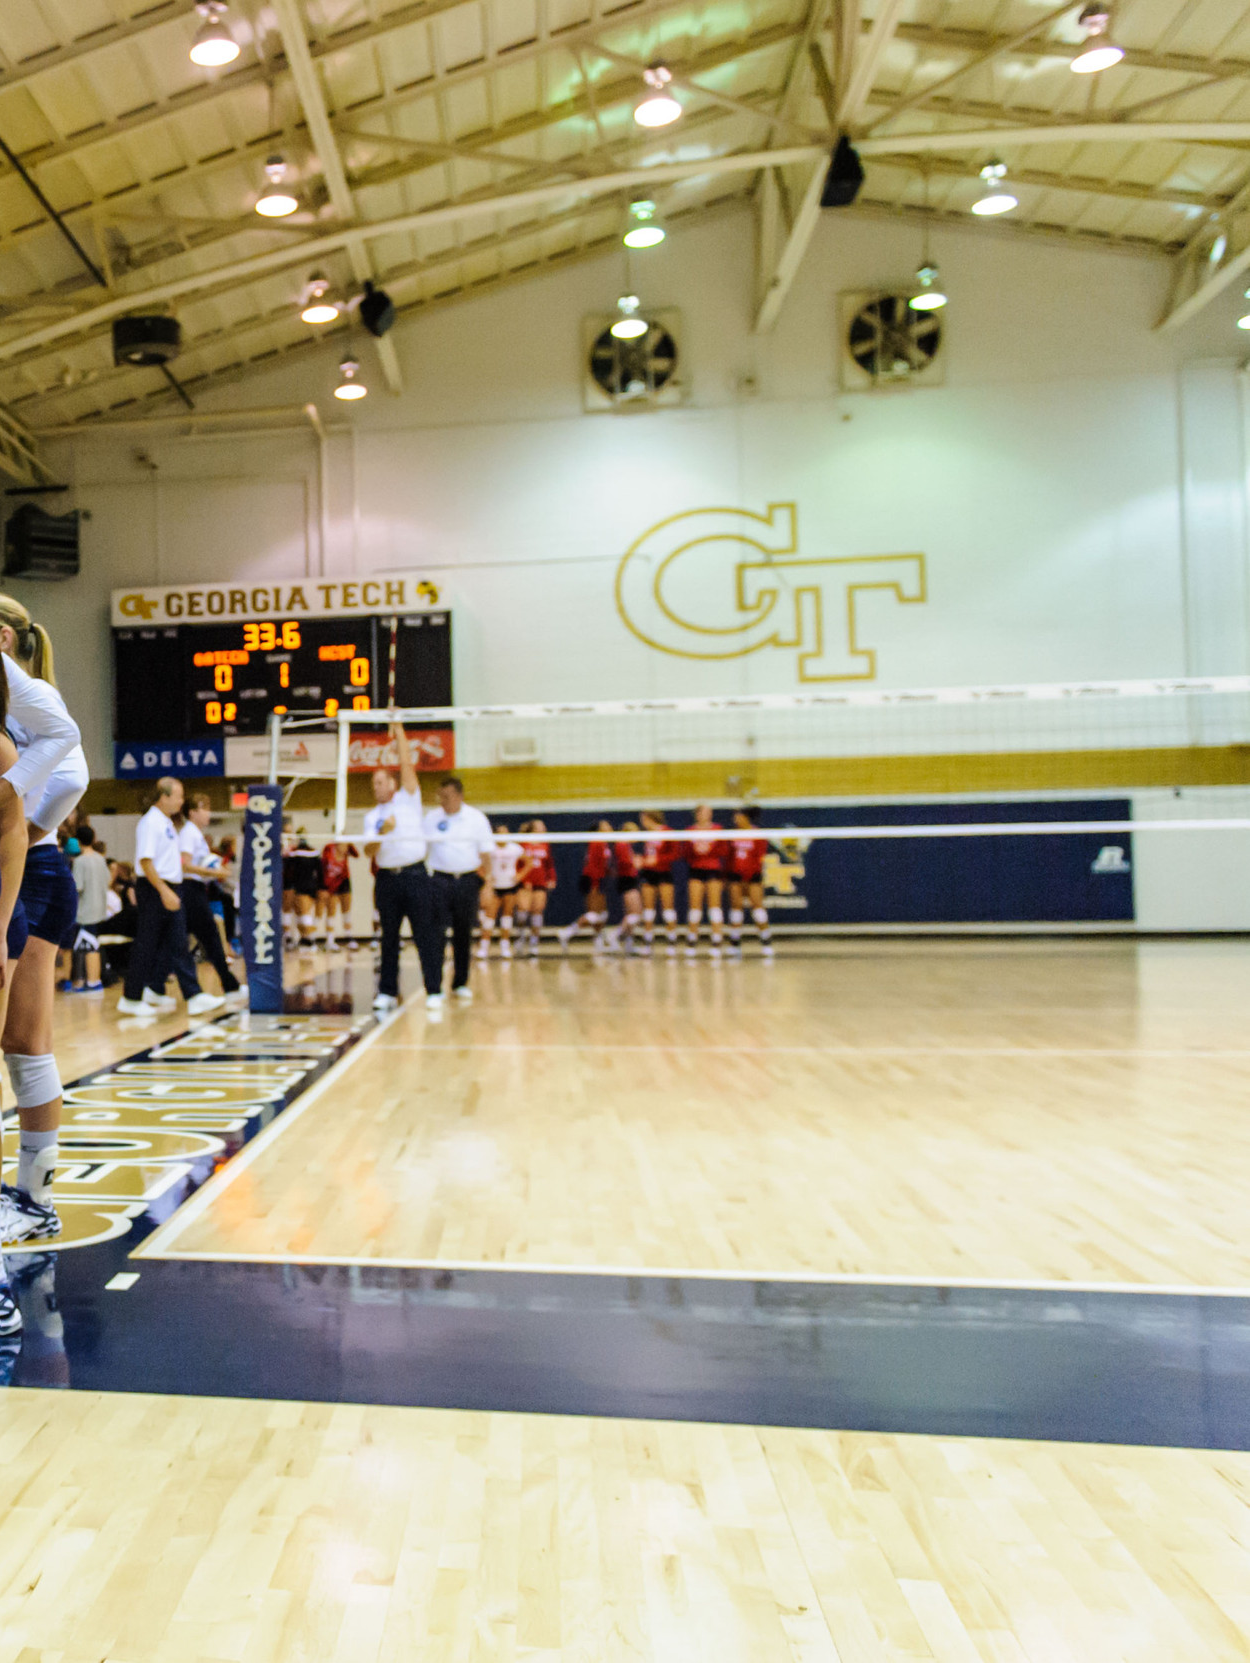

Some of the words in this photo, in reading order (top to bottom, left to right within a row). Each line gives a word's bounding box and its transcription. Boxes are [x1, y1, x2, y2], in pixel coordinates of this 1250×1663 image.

[164, 587, 309, 617] GEORGIA
[317, 580, 406, 610] TECH
[243, 621, 301, 651] 33.6
[214, 664, 233, 692] 0
[350, 657, 370, 687] 0
[143, 749, 218, 767] DELTA
